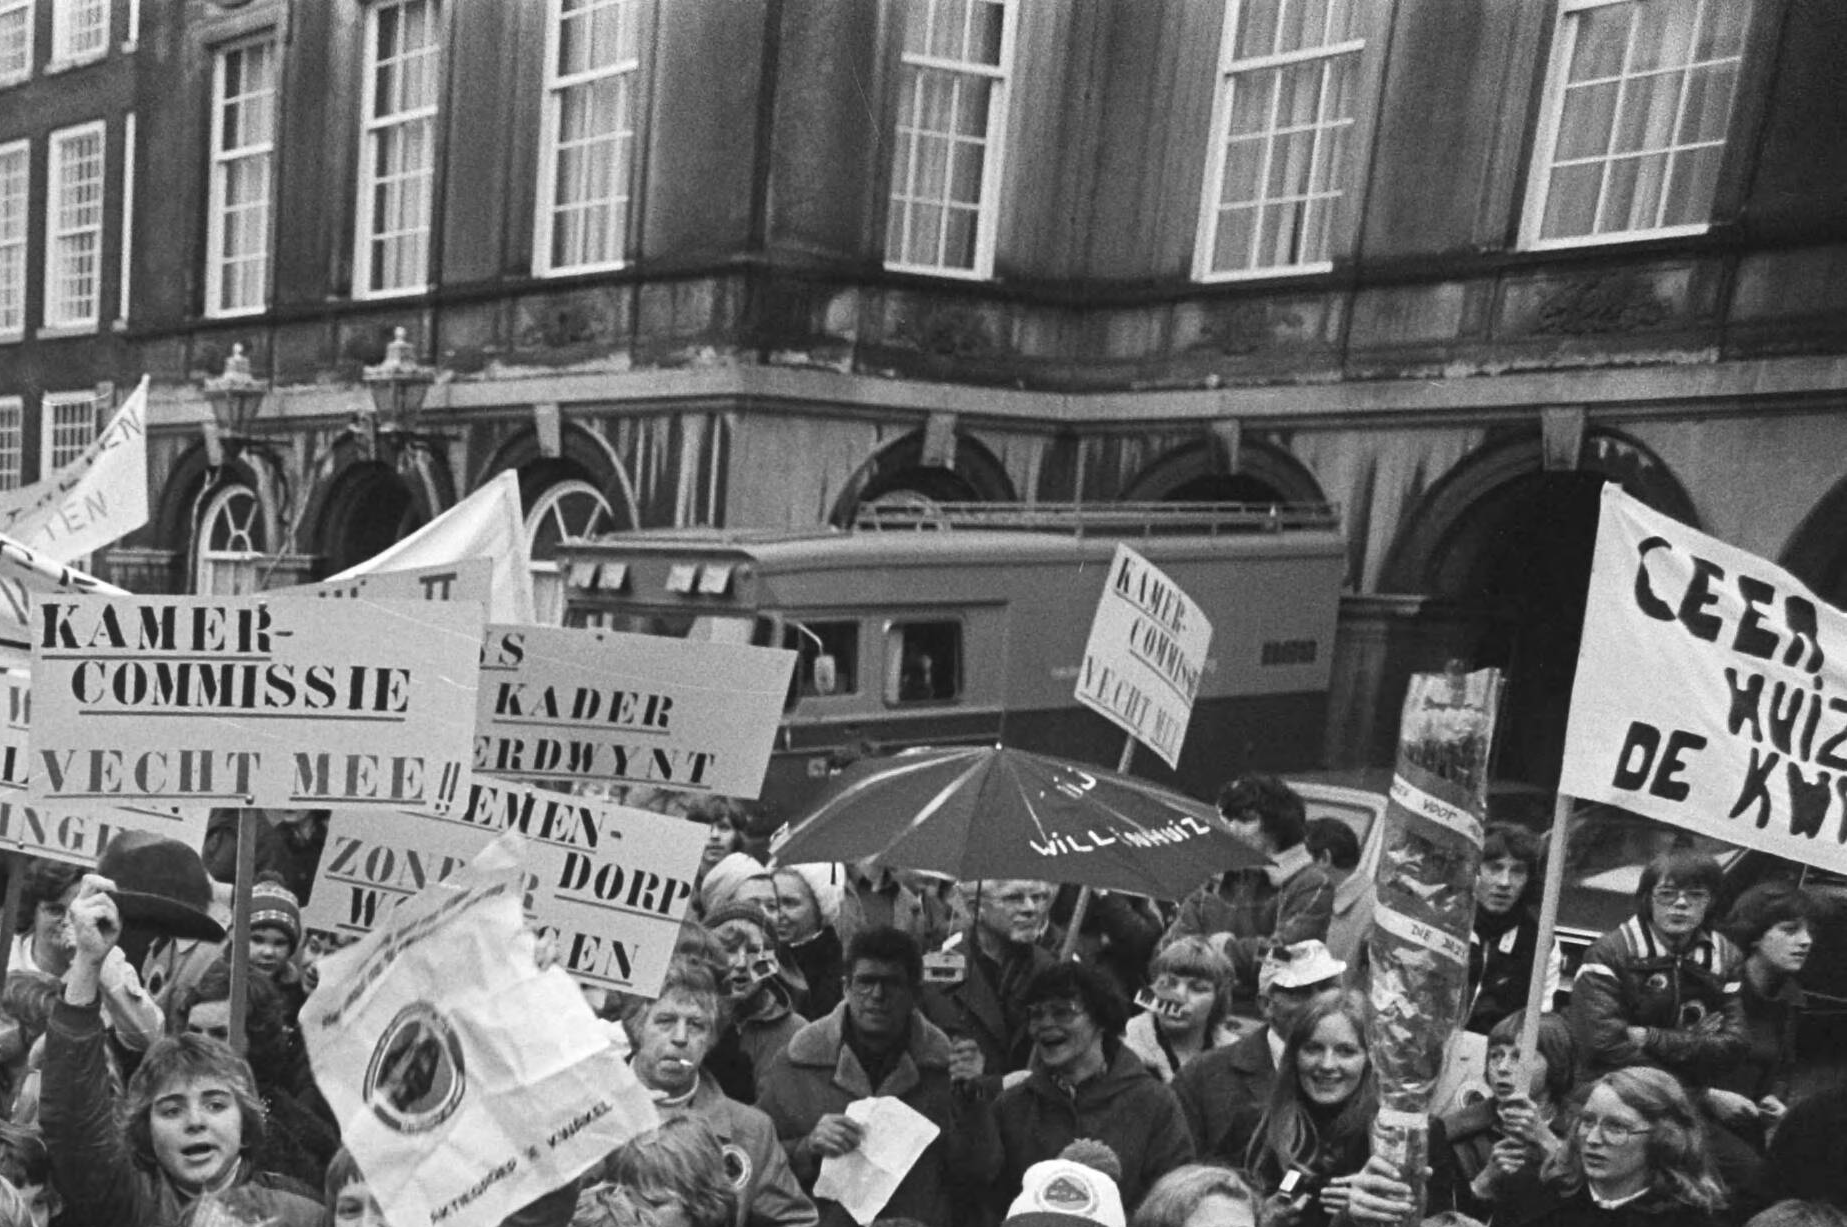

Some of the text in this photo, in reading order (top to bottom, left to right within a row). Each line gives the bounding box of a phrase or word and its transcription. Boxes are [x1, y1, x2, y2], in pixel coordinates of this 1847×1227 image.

[40, 603, 295, 654] KAMER-
[71, 661, 412, 713] COMMISSIE
[494, 682, 675, 730] KADER
[40, 749, 262, 796] VECHT
[1612, 720, 1708, 803] DE
[558, 852, 692, 915] DORP
